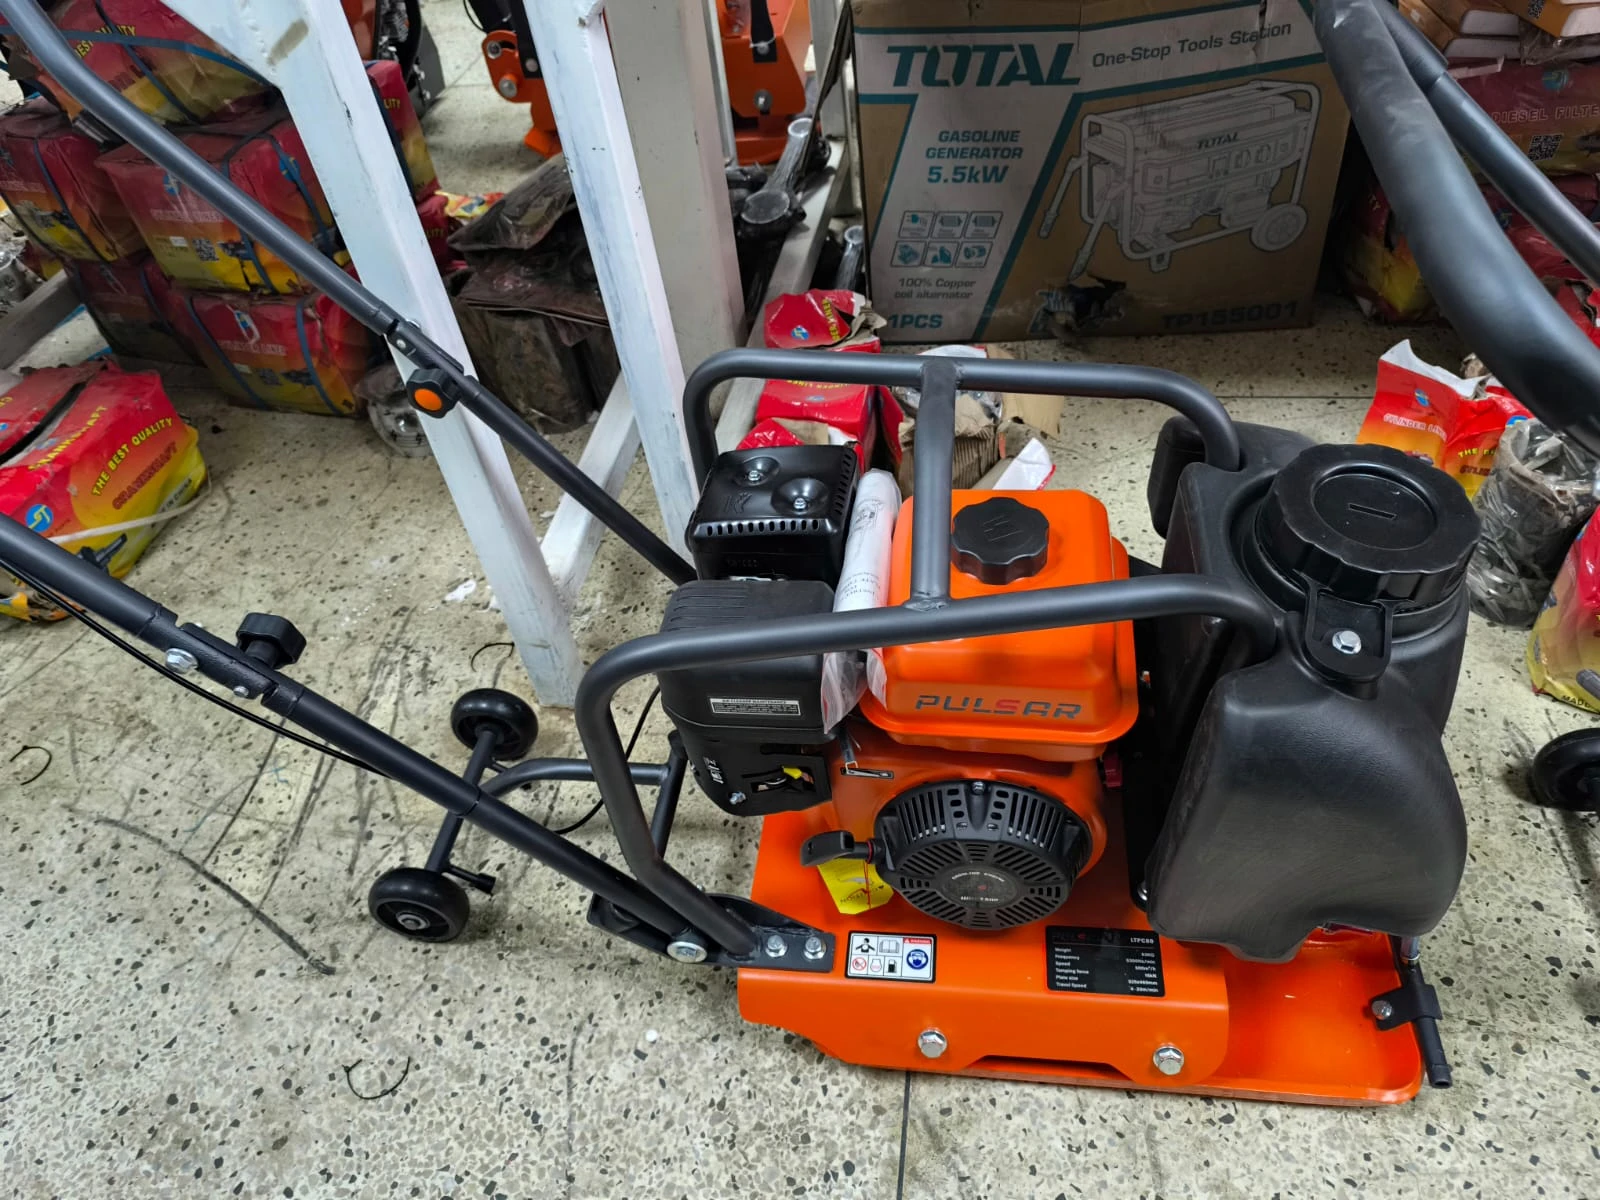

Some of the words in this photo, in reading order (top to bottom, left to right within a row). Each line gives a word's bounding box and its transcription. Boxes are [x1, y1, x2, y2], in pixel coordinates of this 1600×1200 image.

[1092, 44, 1171, 68] One-Stop
[1178, 35, 1223, 54] Tools
[1229, 23, 1291, 46] Station
[887, 43, 1080, 87] TOTAL
[1491, 108, 1548, 123] DIESEL
[938, 129, 1021, 143] GASOLINE
[925, 146, 1024, 160] GENERATOR
[927, 165, 1009, 184] 5.5kW
[898, 277, 932, 288] 100%
[935, 277, 976, 290] Copper
[894, 290, 913, 299] coil
[915, 290, 974, 299] alternator
[888, 313, 943, 329] 1PCS
[92, 470, 111, 497] THE
[107, 443, 130, 471] BEST
[131, 417, 174, 447] QUALITY
[1458, 447, 1479, 458] THE
[915, 694, 1082, 719] PULSAR
